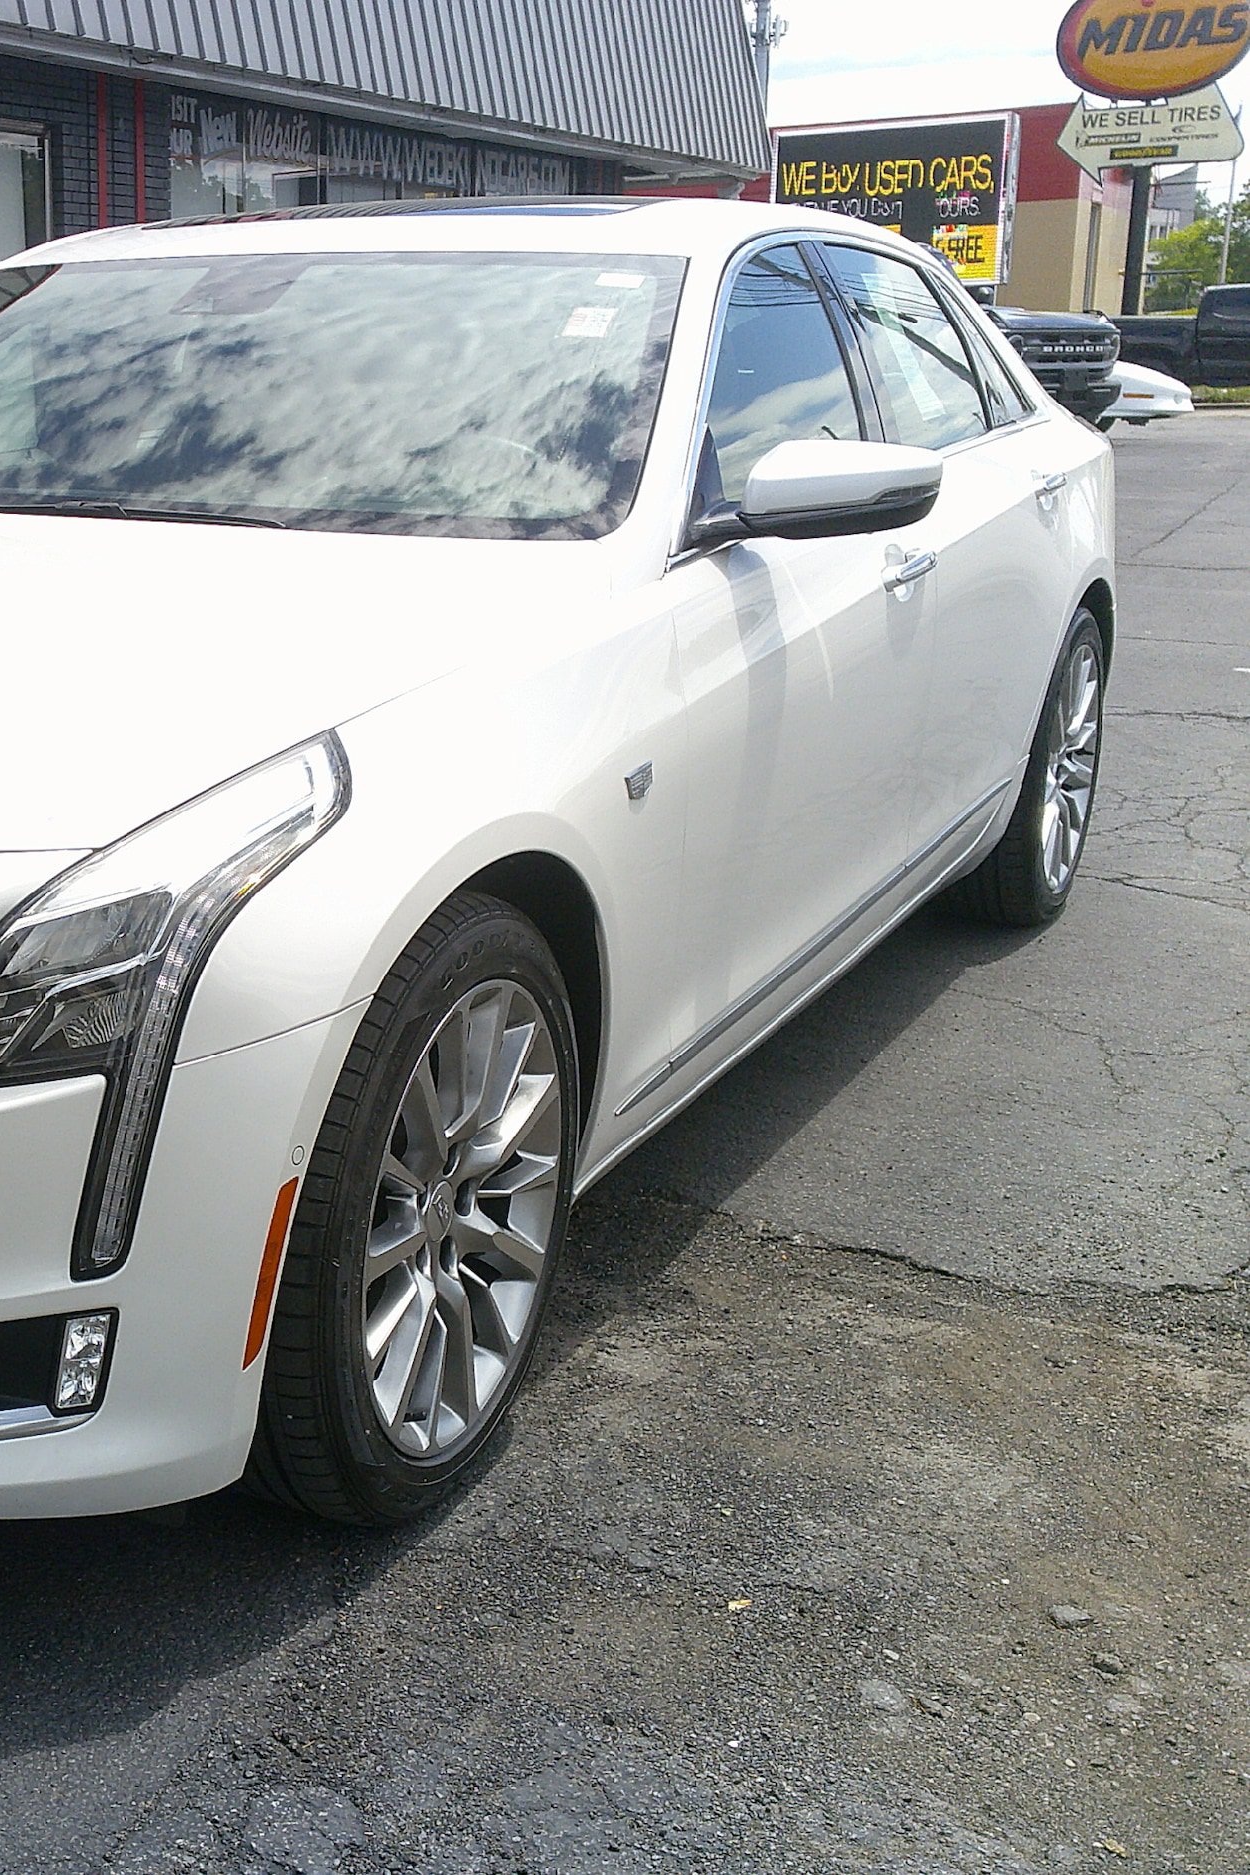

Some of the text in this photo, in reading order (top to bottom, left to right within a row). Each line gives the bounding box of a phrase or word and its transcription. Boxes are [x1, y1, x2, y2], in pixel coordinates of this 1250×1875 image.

[1076, 3, 1250, 63] MIDAS
[170, 94, 197, 123] ISIT
[1082, 105, 1222, 129] WE SELL TIRES
[168, 127, 193, 155] UR
[246, 107, 311, 162] Website
[782, 161, 817, 196] WE
[842, 198, 868, 217] YOU
[1042, 345, 1105, 353] BRONCO
